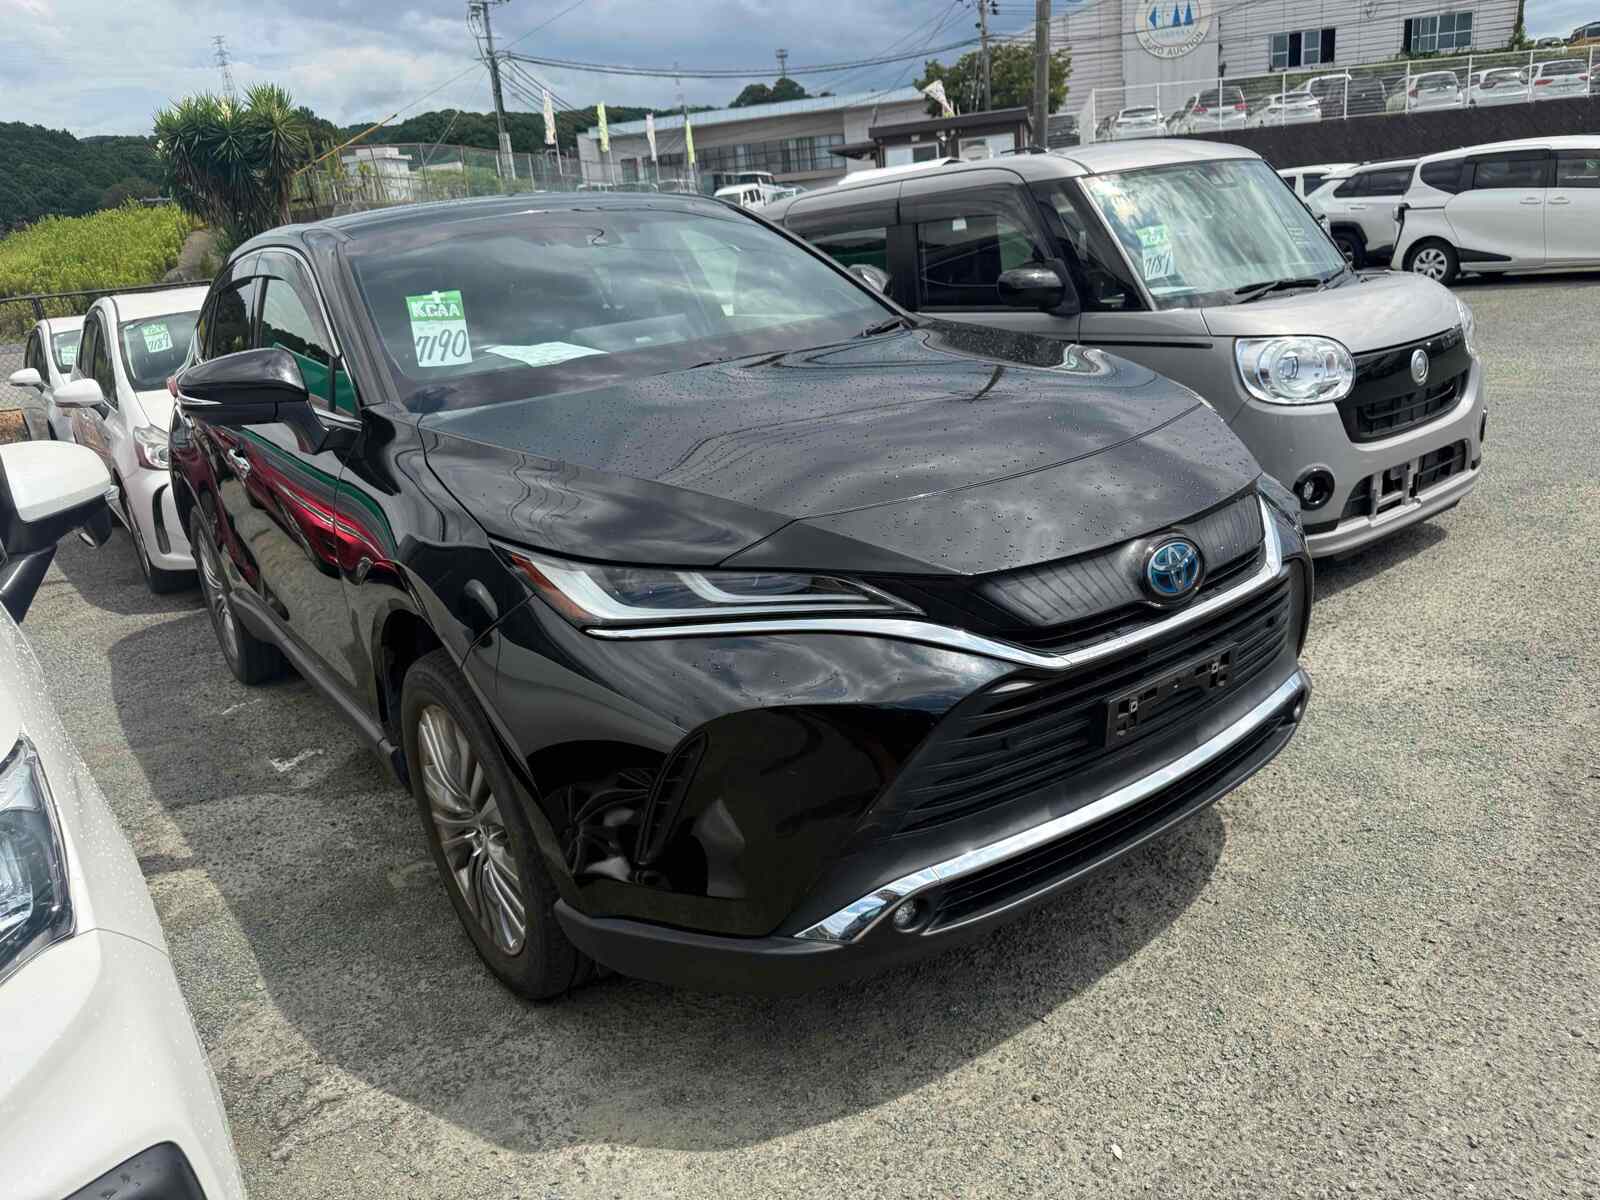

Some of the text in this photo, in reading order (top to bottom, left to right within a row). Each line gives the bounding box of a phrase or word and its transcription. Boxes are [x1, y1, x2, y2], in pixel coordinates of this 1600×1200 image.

[1167, 31, 1204, 56] AUCTION
[411, 302, 461, 318] KCAA
[416, 329, 467, 362] 7190
